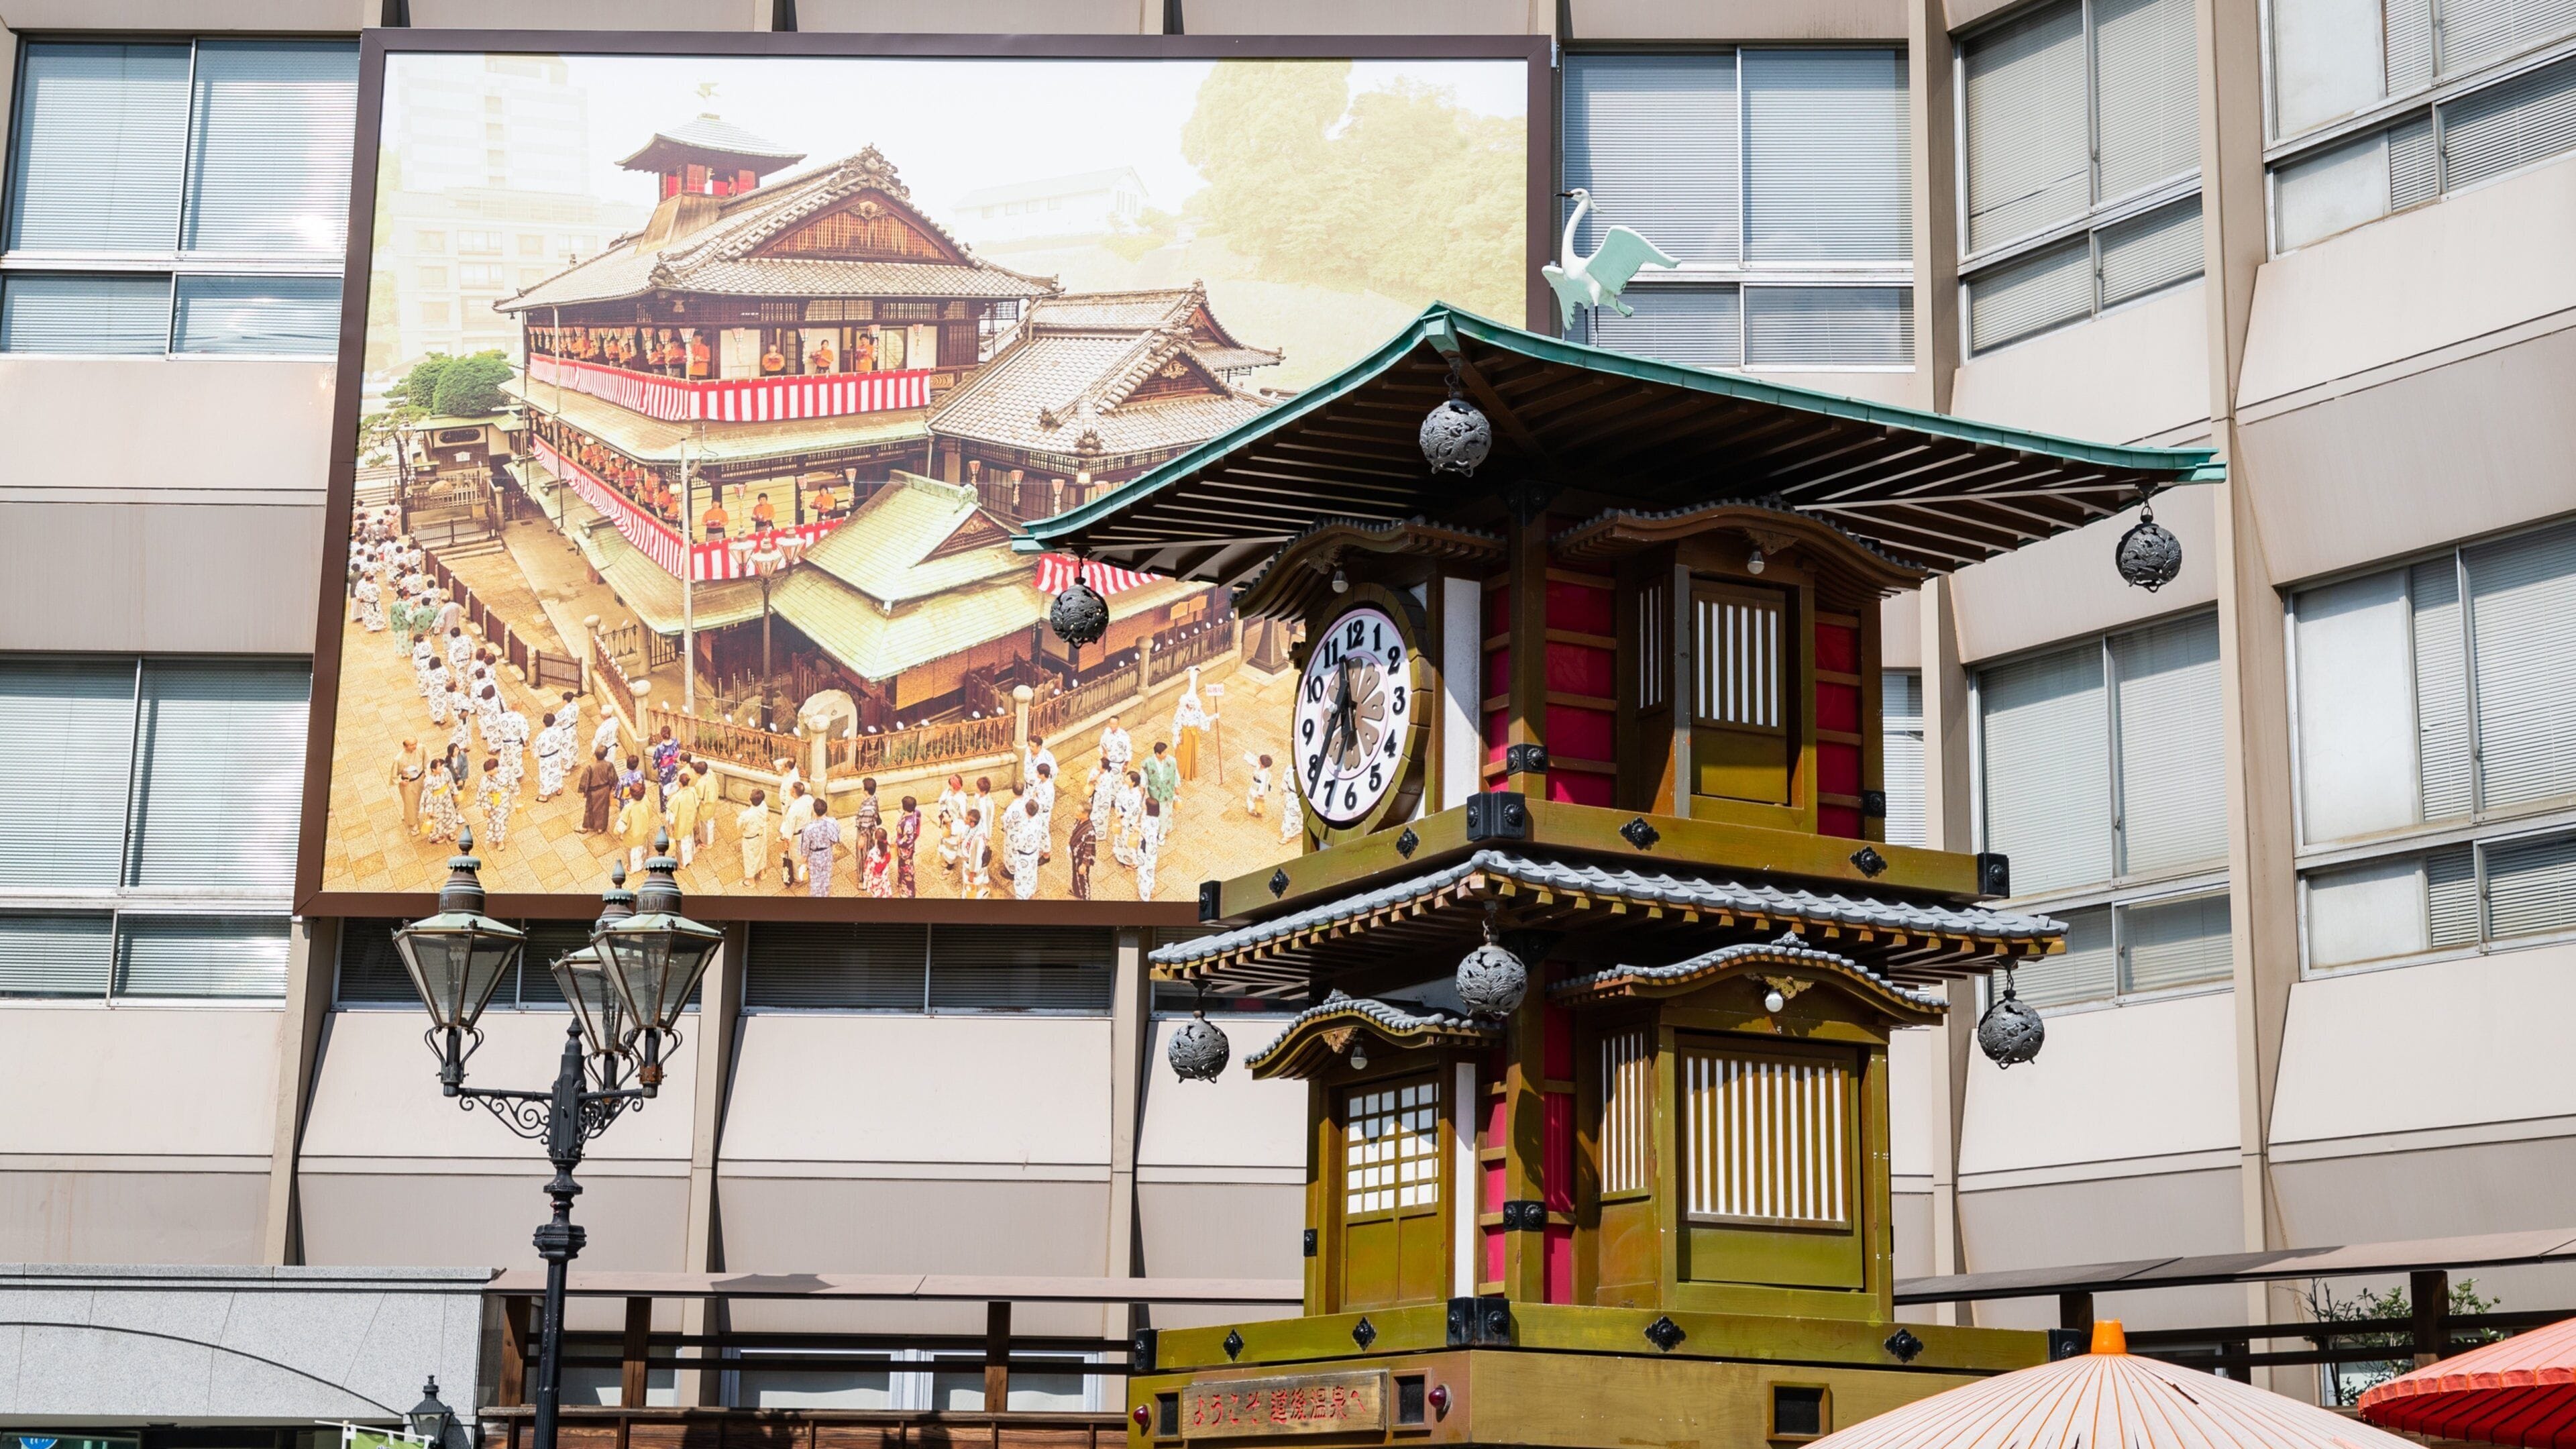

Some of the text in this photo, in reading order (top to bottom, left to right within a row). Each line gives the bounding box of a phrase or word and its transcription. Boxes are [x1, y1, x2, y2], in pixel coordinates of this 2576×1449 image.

[1346, 620, 1364, 651] 12
[1373, 623, 1381, 651] 1
[1324, 638, 1338, 669] 11
[1387, 646, 1401, 675] 2
[1307, 676, 1324, 703] 10
[1392, 686, 1405, 715] 3
[1302, 718, 1315, 746] 9
[1384, 729, 1396, 759] 4
[1368, 763, 1382, 792] 5
[1324, 779, 1335, 808] 7
[1344, 782, 1357, 811] 6
